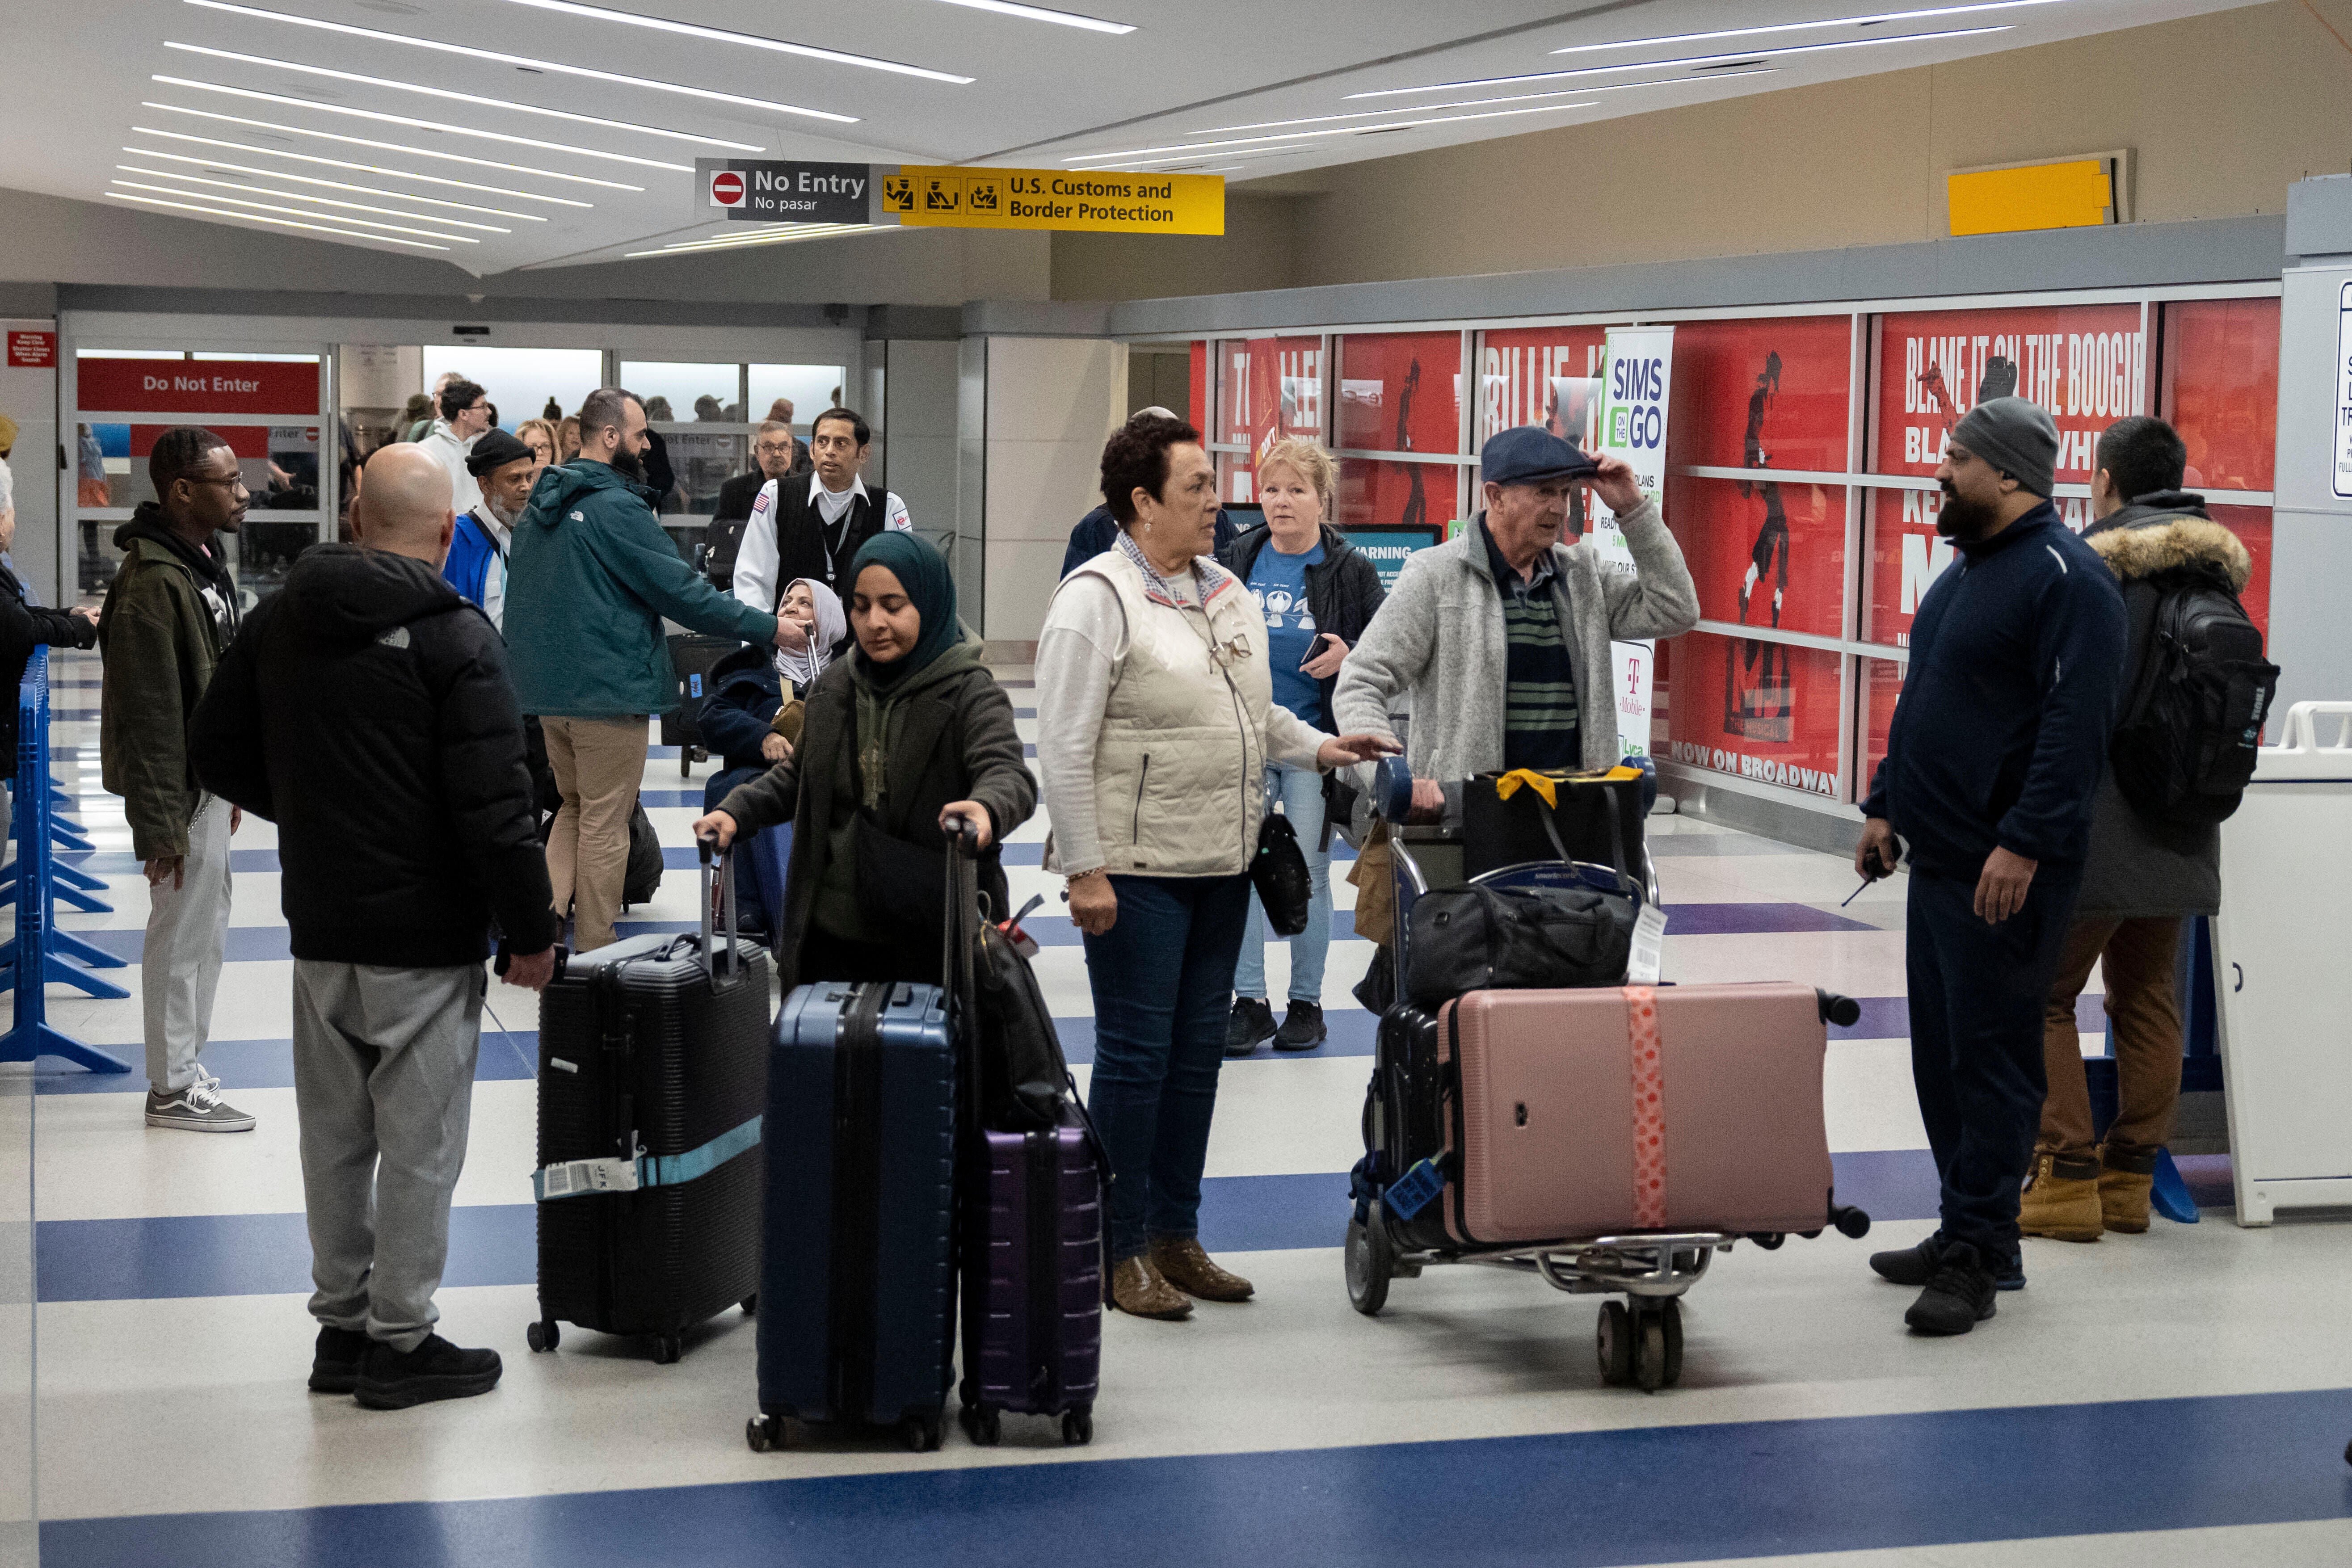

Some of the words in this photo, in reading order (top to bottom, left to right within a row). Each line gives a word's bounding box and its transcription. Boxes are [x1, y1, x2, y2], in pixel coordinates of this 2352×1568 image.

[755, 171, 789, 191] No
[799, 172, 865, 199] Entry
[1010, 177, 1046, 194] U.S.
[1052, 179, 1131, 197] Customs
[1137, 182, 1171, 199] and
[755, 196, 774, 209] No
[780, 199, 817, 212] pasar
[1010, 201, 1073, 218] Border
[1079, 203, 1174, 222] Protection
[143, 375, 168, 391] Do
[175, 376, 207, 392] Not
[213, 376, 260, 392] Enter
[1613, 358, 1662, 401] SIMS
[1616, 428, 1626, 438] THE
[1617, 416, 1625, 426] ON
[1630, 405, 1662, 449] GO
[1355, 546, 1412, 559] ARNING
[1671, 740, 1711, 766] NOW
[1713, 748, 1738, 773] ON
[1742, 754, 1838, 795] BROADWAY
[597, 1165, 608, 1188] JFK
